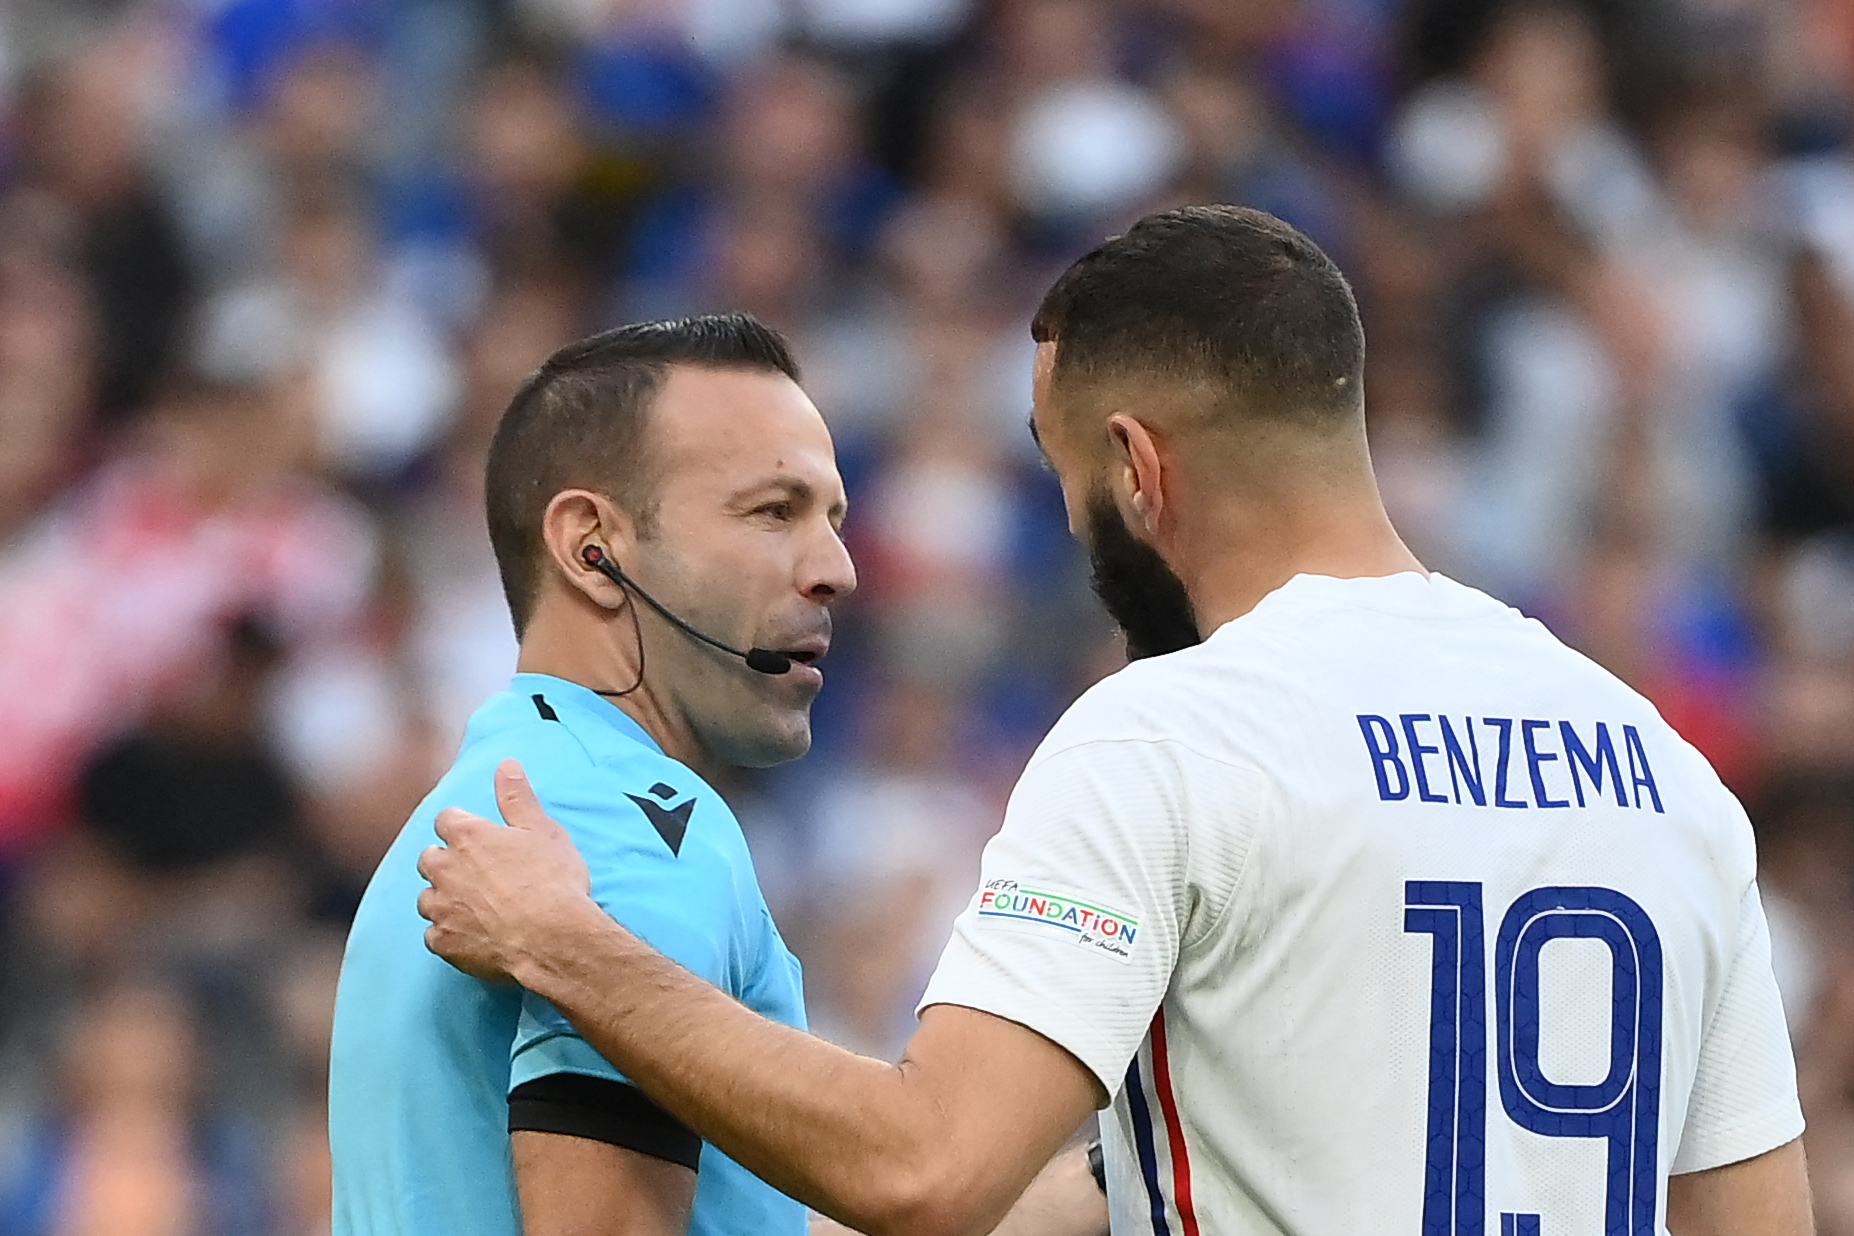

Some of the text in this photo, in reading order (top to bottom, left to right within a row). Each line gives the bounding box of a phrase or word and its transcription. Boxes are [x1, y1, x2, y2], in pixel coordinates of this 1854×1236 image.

[1355, 713, 1666, 815] BENZEMA
[984, 879, 1020, 892] UEFA
[1095, 939, 1129, 958] children
